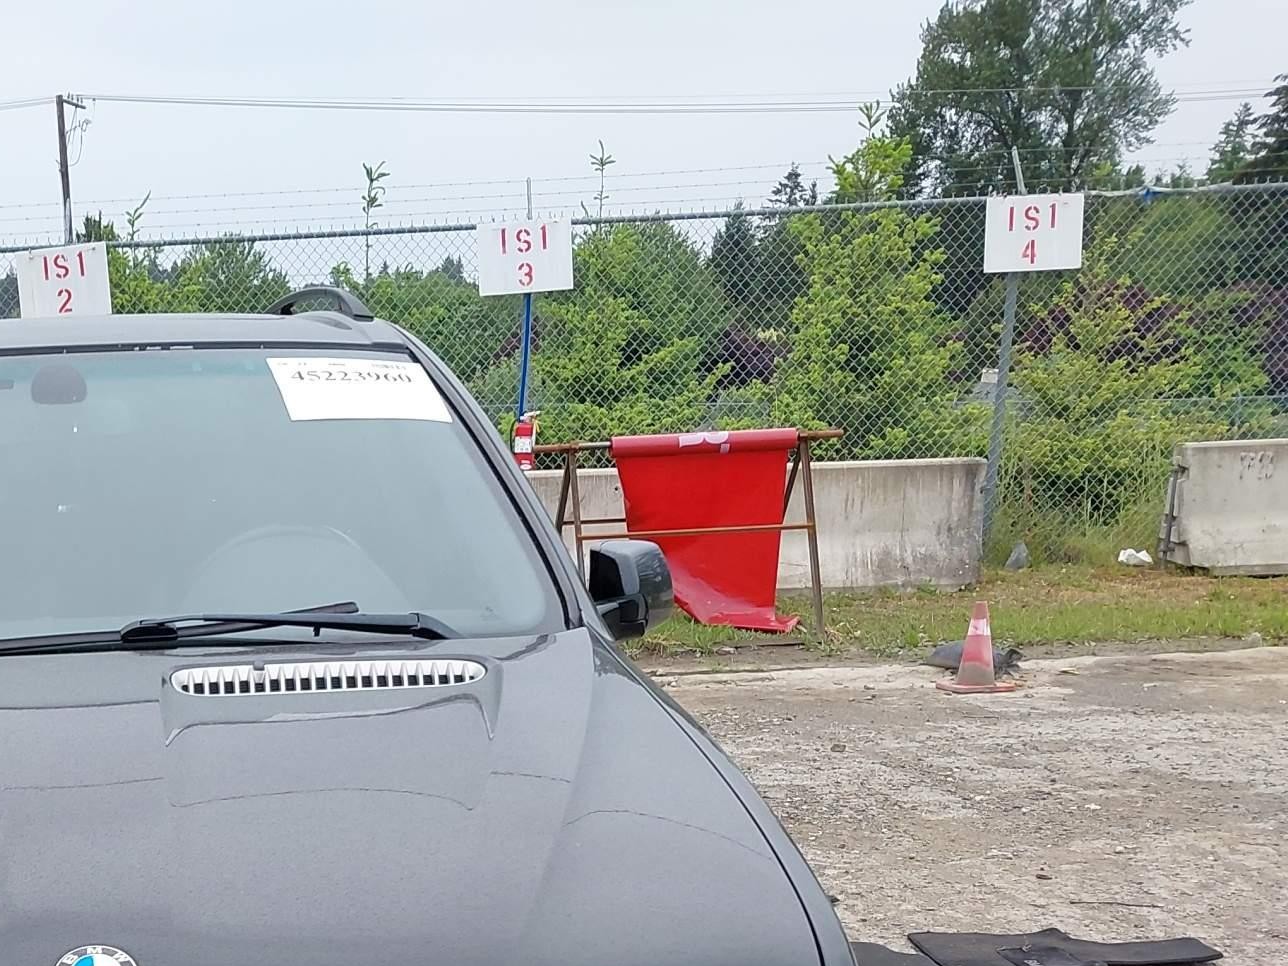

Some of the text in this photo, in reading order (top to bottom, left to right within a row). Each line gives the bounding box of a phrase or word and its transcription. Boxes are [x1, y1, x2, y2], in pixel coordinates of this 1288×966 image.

[1022, 240, 1036, 264] 4
[518, 263, 533, 287] 3
[57, 289, 73, 313] 2
[291, 370, 412, 382] 45223960
[63, 946, 130, 964] BMW
